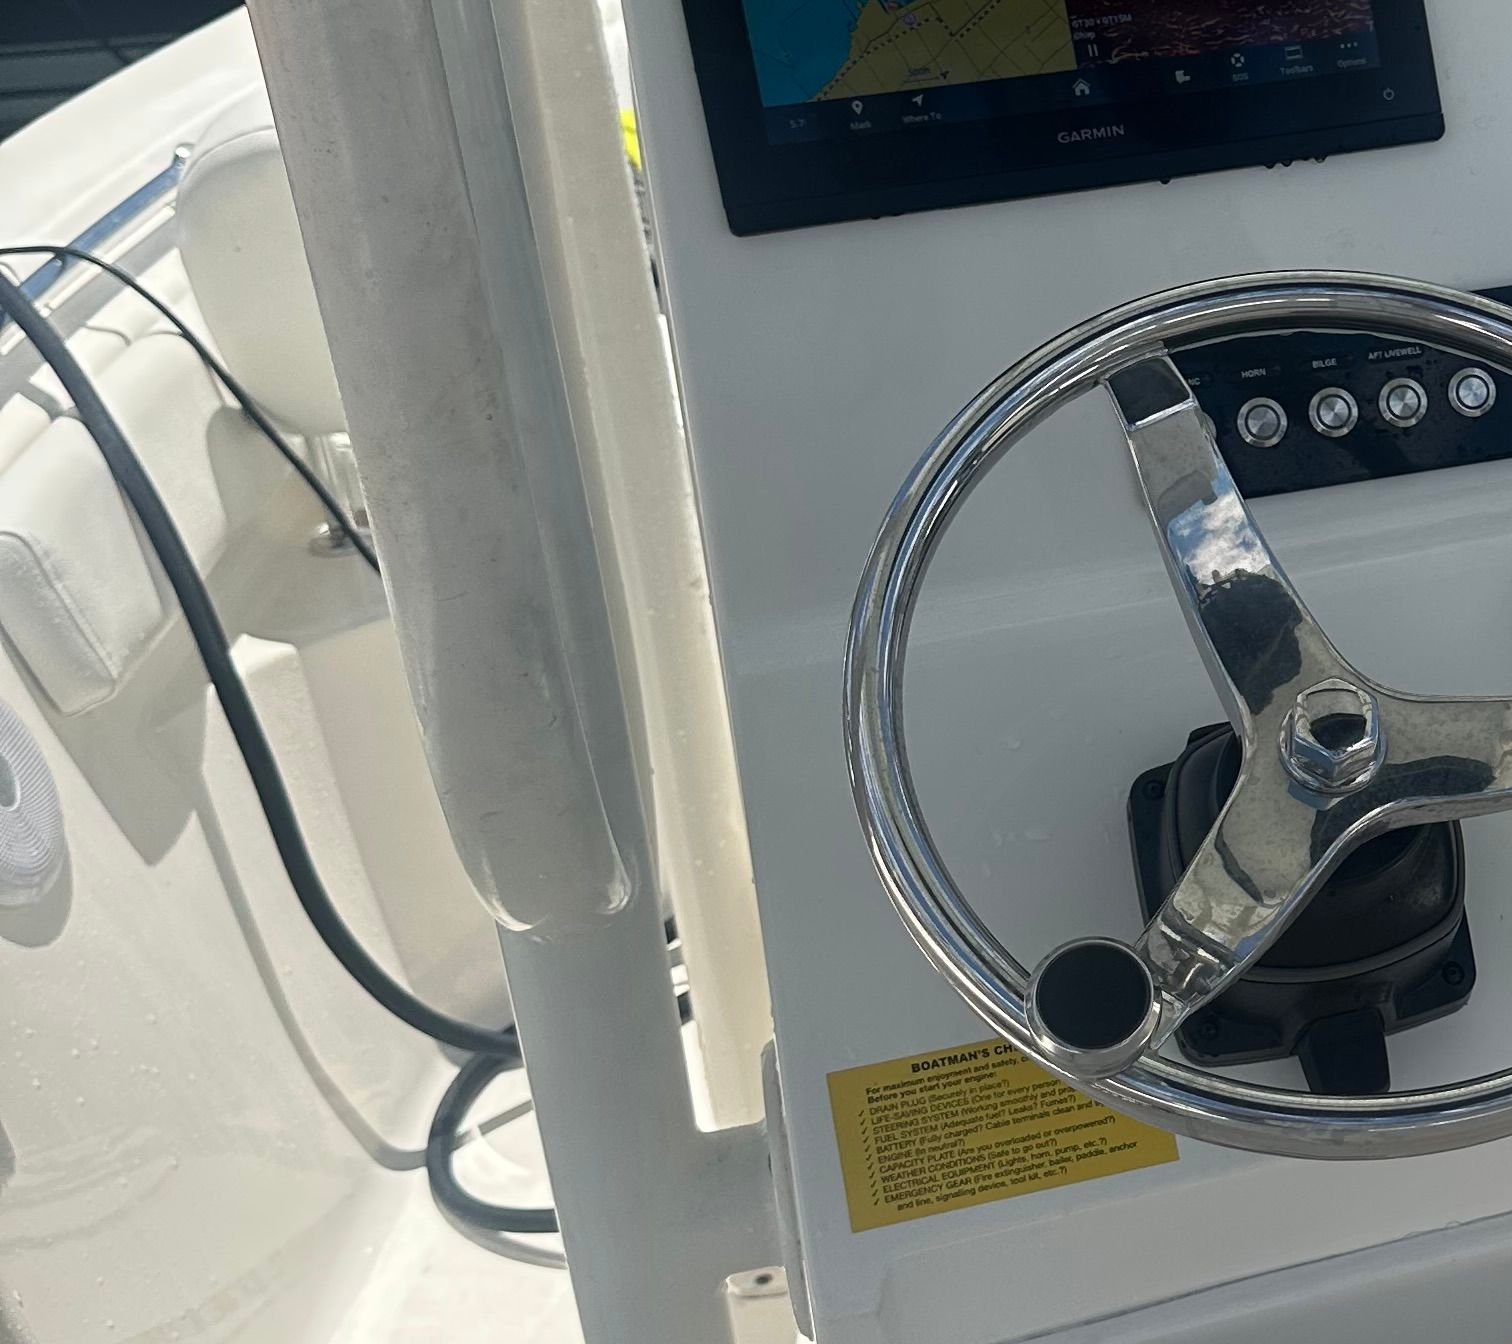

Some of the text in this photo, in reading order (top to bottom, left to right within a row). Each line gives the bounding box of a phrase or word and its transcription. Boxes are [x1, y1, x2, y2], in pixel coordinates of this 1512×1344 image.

[1057, 124, 1126, 144] GARMIN
[1312, 358, 1337, 368] BILGE
[1368, 346, 1421, 360] AFT LIVEWELL
[1241, 368, 1266, 378] HORN
[911, 1048, 989, 1072] BOATMAN'S
[865, 1062, 989, 1095] For maximum enjoyment and
[867, 1078, 962, 1104] Before you start your
[869, 1096, 926, 1115] DRAIN PLUG
[870, 1085, 1030, 1125] LIFE-SAVING DEVICES for every
[872, 1118, 919, 1135] STEERING
[920, 1109, 959, 1124] SYSTEM
[999, 1093, 1038, 1107] smoothly
[1040, 1088, 1056, 1098] and
[874, 1132, 898, 1144] FUEL
[900, 1124, 938, 1138] SYSTEM
[875, 1138, 916, 1154] BATTERY
[985, 1119, 1010, 1130] Cable
[1011, 1110, 1050, 1124] terminals
[1052, 1105, 1075, 1115] clean
[877, 1149, 912, 1164] ENGINE
[879, 1156, 924, 1173] CAPACITY
[926, 1149, 955, 1163] PLATE
[975, 1143, 992, 1153] you
[994, 1131, 1041, 1148] overloaded
[880, 1166, 926, 1183] WEATHER
[927, 1153, 986, 1173] CONDITIONS
[1022, 1144, 1034, 1153] go
[882, 1161, 995, 1193] ELECTRICAL EQUIPMENT
[884, 1141, 1137, 1203] EMERGENCY GEAR anchor
[897, 1200, 914, 1211] and
[1009, 1175, 1026, 1184] tool
